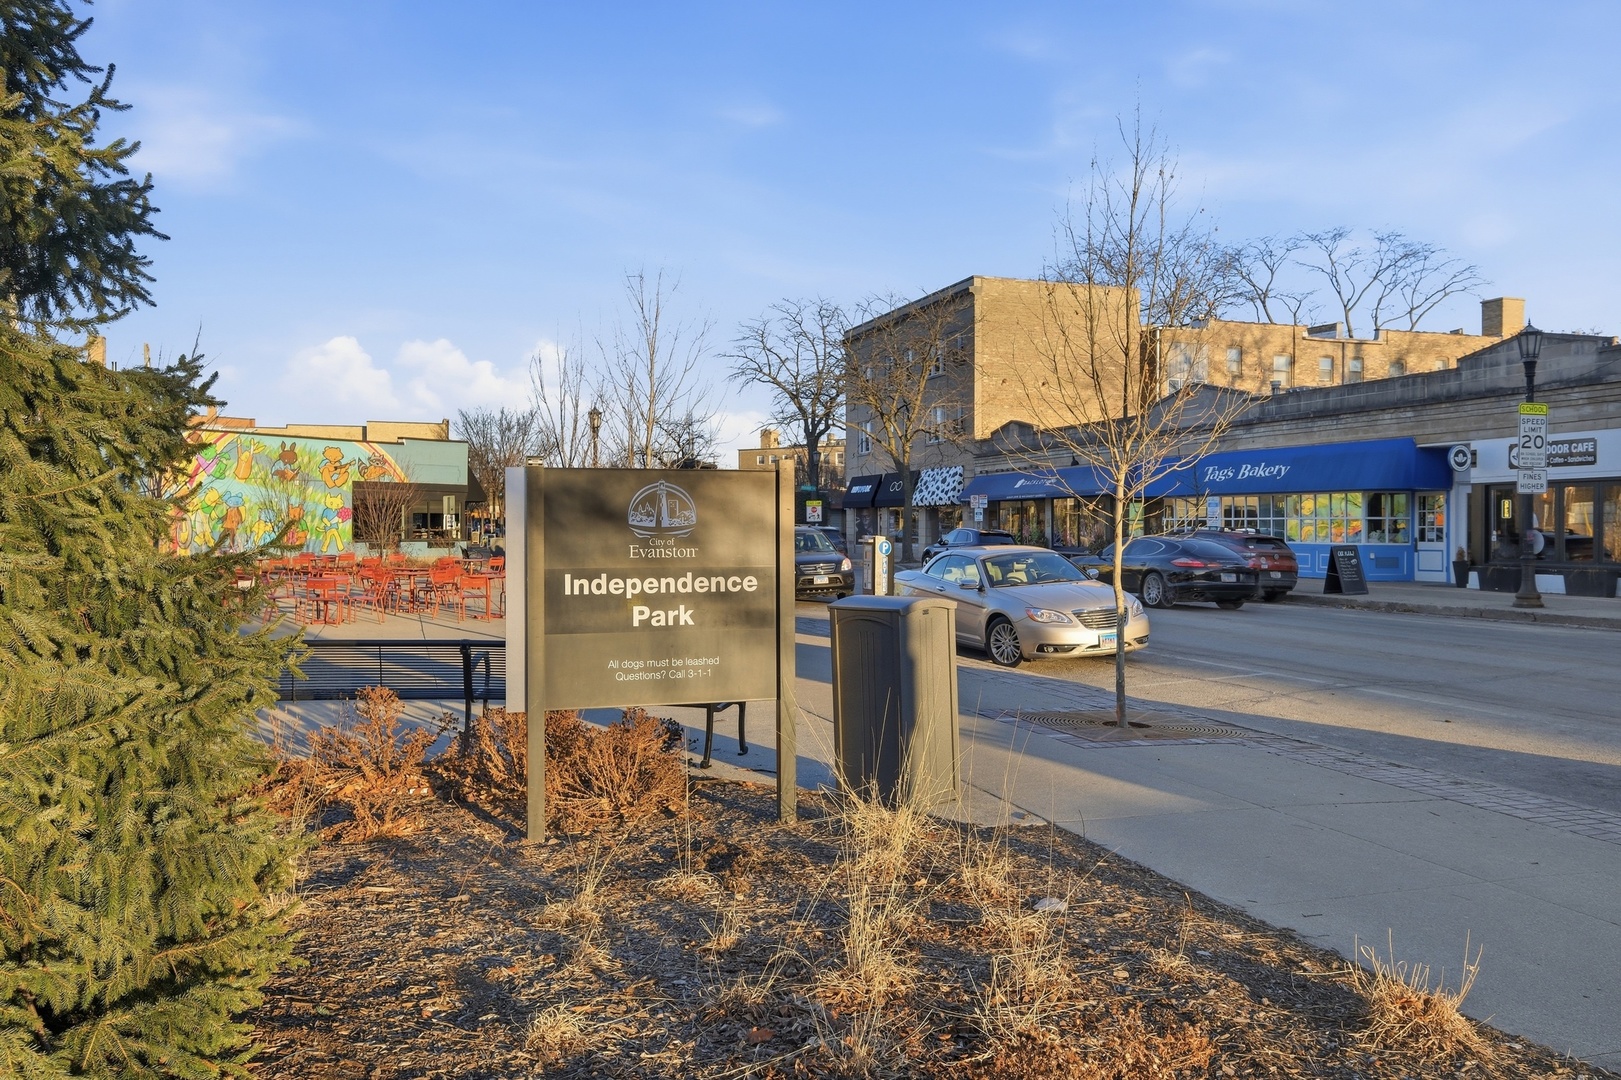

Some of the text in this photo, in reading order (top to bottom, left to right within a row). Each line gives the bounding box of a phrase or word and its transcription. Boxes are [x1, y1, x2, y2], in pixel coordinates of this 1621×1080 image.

[1521, 434, 1544, 449] 20
[1571, 442, 1594, 452] CAFE
[1204, 462, 1291, 482] Tag's Bakery
[649, 537, 675, 548] City of
[882, 542, 888, 554] P
[629, 544, 696, 558] Evanston
[564, 572, 758, 599] Independence
[632, 604, 695, 627] Park
[608, 656, 720, 670] All dogs must be leashed
[616, 668, 712, 681] Questions? Call 3-1-1
